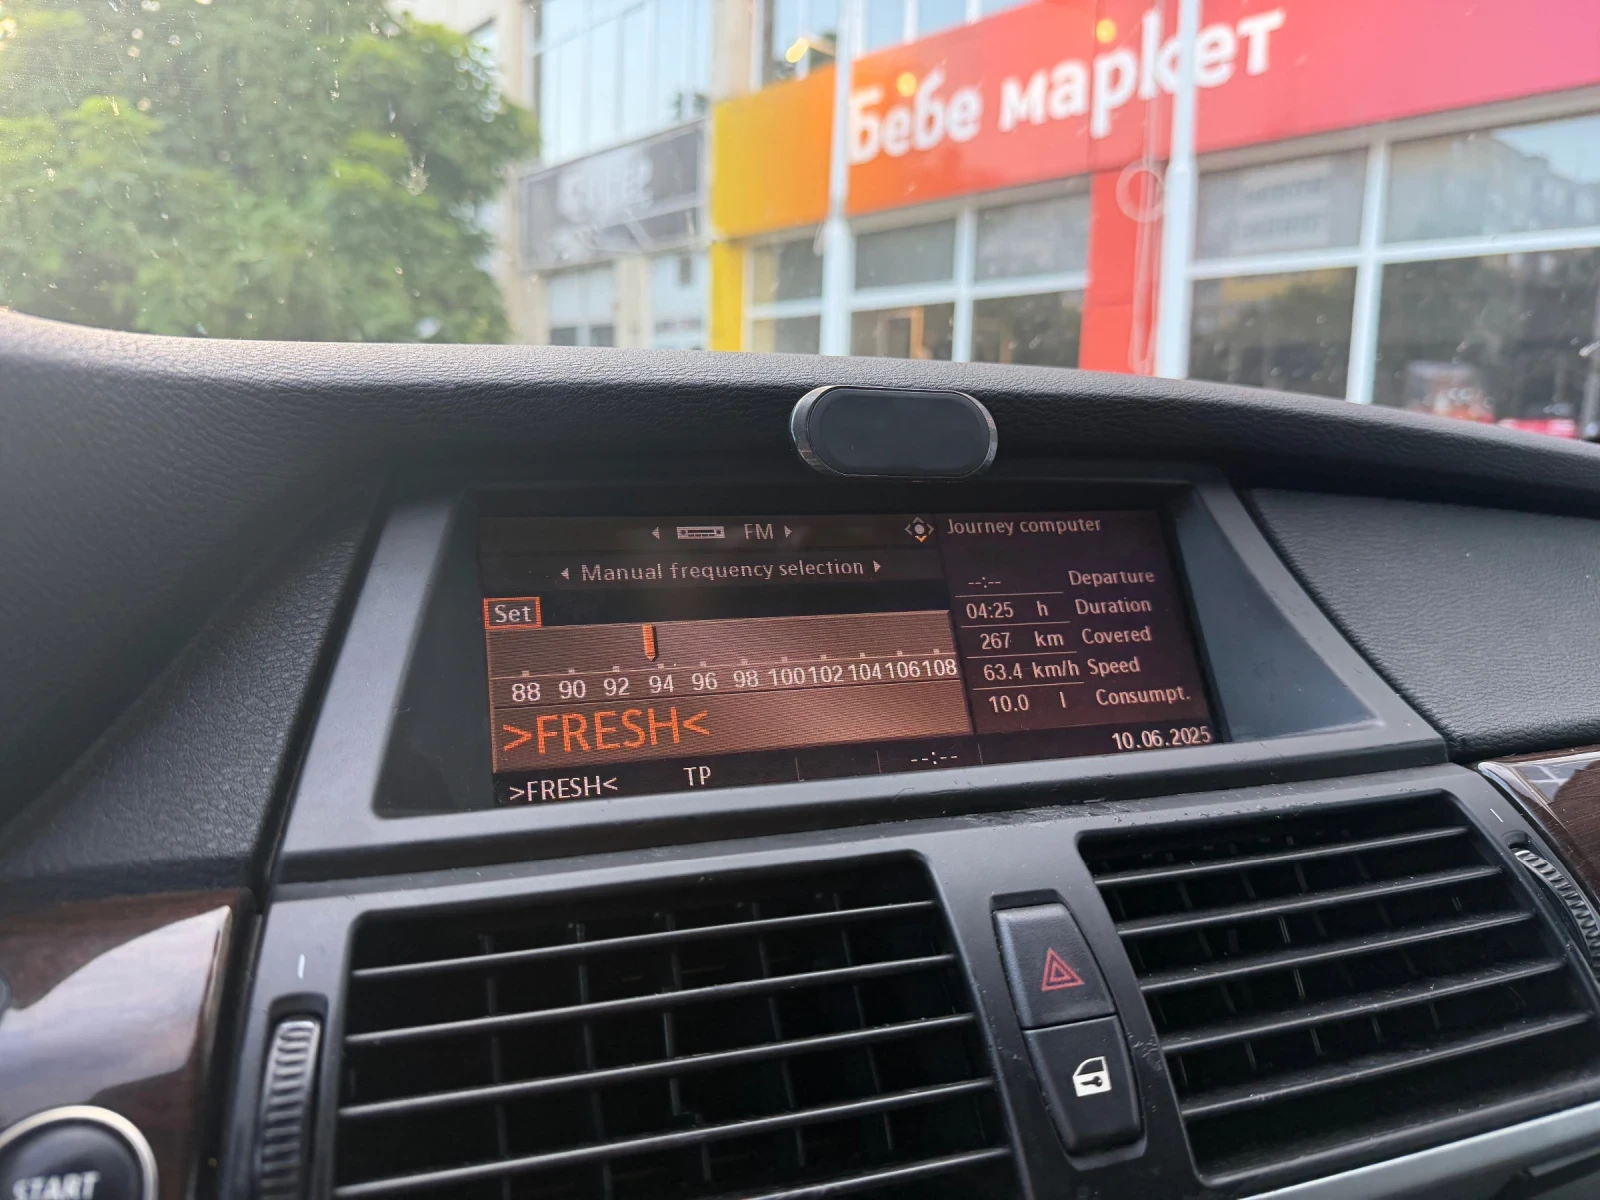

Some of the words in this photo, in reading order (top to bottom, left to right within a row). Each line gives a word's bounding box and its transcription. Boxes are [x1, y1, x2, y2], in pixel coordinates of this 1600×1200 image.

[847, 66, 982, 165] Бебе
[1000, 8, 1287, 138] маркет
[744, 523, 774, 540] FM
[948, 519, 1014, 536] Journey
[1020, 519, 1101, 535] computer
[581, 563, 663, 582] Manual
[669, 562, 774, 581] frequency
[779, 559, 864, 577] selection
[1068, 570, 1155, 587] Departure
[494, 605, 532, 623] Set
[966, 601, 1014, 620] 04:25
[1037, 600, 1049, 616] h
[1075, 597, 1152, 615] Duration
[980, 632, 1011, 650] 267
[1034, 630, 1064, 647] km
[1082, 626, 1152, 645] Covered
[983, 662, 1023, 681] 63.4
[1032, 661, 1080, 679] km/h
[1087, 656, 1140, 677] Speed
[511, 683, 541, 702] 88
[559, 680, 586, 699] 90
[603, 677, 630, 696] 92
[648, 675, 675, 694] 94
[691, 673, 718, 691] 96
[733, 671, 759, 688] 98
[769, 668, 805, 686] 100
[808, 666, 844, 684] 102
[847, 663, 882, 682] 104
[885, 661, 921, 679] 106
[922, 658, 957, 677] 108
[988, 695, 1029, 713] 10.0
[1095, 686, 1191, 707] Consumpt.
[503, 707, 710, 754] >FRESH<
[1112, 727, 1211, 750] 10.06.2025
[683, 766, 711, 786] TP
[509, 775, 619, 801] >FRESH<
[12, 1170, 100, 1200] START
